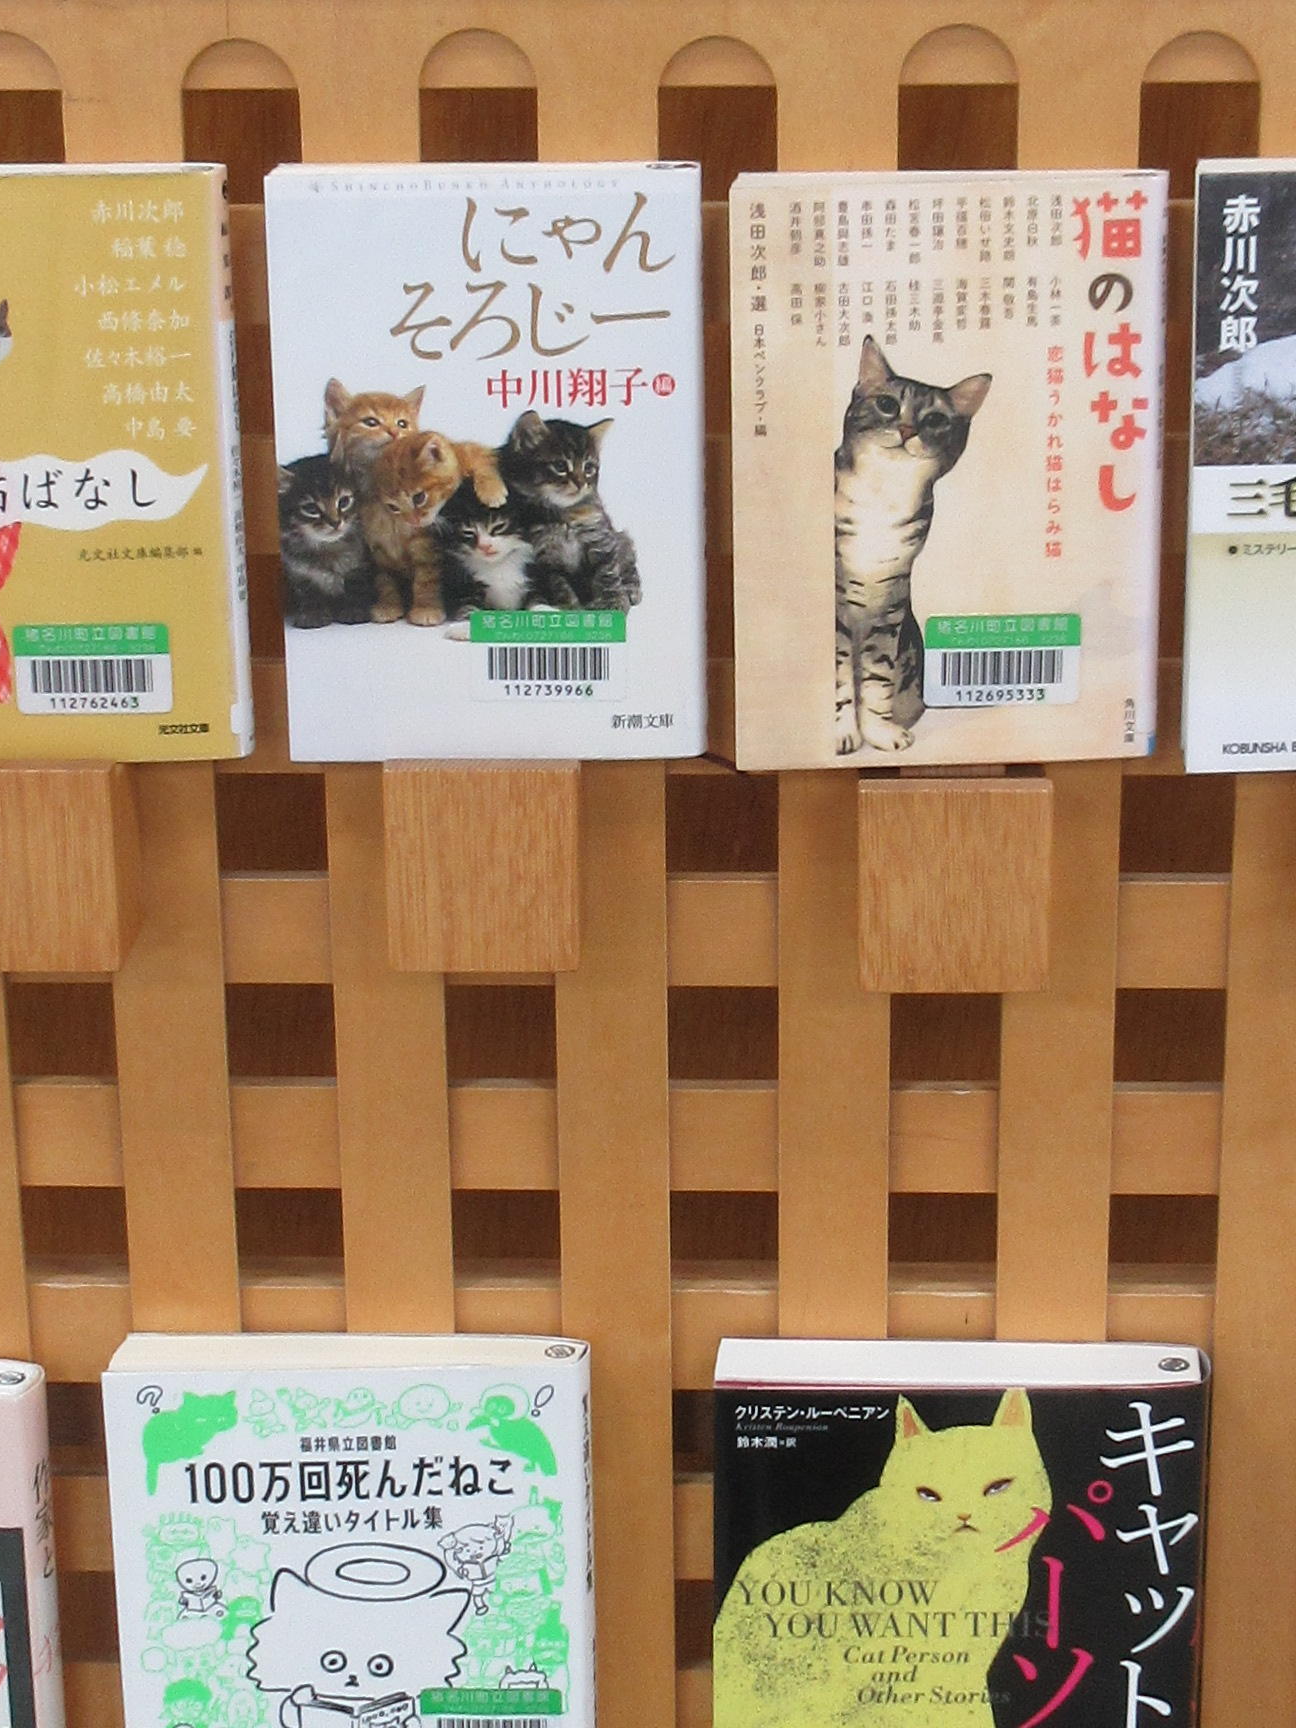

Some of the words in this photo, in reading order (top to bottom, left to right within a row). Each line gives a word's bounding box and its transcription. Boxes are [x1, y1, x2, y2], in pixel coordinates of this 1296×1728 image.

[92, 199, 184, 224] 赤川次郎
[462, 192, 676, 273] にゃん
[75, 274, 185, 297] 小松エメル
[1218, 193, 1262, 354] 赤川次郎
[390, 280, 671, 361] そろじー
[85, 346, 192, 369] 佐々木裕一
[1072, 189, 1150, 512] 猫のはなし
[104, 380, 194, 405] 高橋由太
[487, 369, 647, 409] 中川翔子
[1046, 345, 1064, 558] 恋猫うかれ猫はらみ猫
[49, 696, 140, 709] 112762463
[504, 684, 594, 697] 112739966
[955, 688, 1046, 702] 112695333
[611, 712, 675, 729] 新潮文庫
[1222, 741, 1288, 756] KOBUNSHA
[735, 1405, 890, 1421] クリステン・ルーペニアン
[299, 1435, 397, 1453] 福井県立図書館
[184, 1456, 514, 1505] 100万回死んだねこ
[260, 1509, 444, 1535] 覚え違いタイトル集
[738, 1580, 815, 1606] YOU
[822, 1579, 941, 1606] KNOW
[764, 1612, 842, 1639] YOU
[850, 1611, 956, 1639] WANT
[963, 1610, 1053, 1639] THIS
[843, 1645, 888, 1665] Cat
[891, 1645, 971, 1665] Person
[870, 1665, 918, 1684] and
[857, 1685, 925, 1706] Other
[929, 1685, 1012, 1706] Stories
